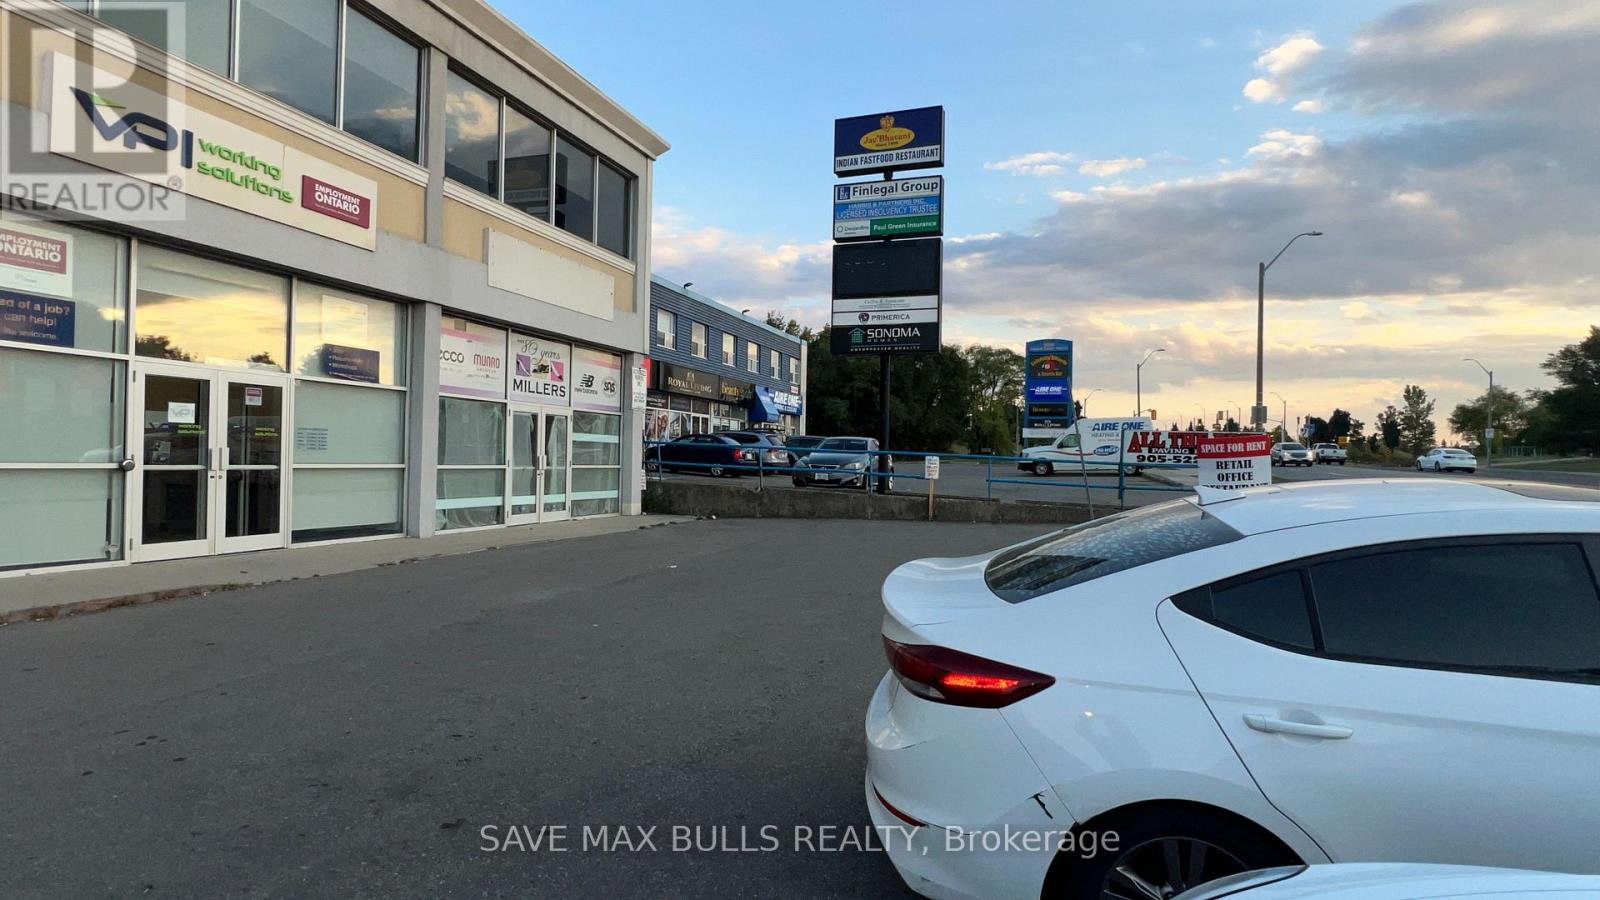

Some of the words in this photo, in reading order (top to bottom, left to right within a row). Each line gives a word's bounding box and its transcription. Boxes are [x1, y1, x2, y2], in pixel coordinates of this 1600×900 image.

[198, 138, 282, 181] working
[836, 156, 859, 169] INDIAN
[860, 153, 894, 166] FASTFOOD
[895, 147, 939, 161] RESTAURANT
[197, 161, 295, 204] solutions
[852, 183, 898, 197] Finlegal
[901, 181, 939, 193] Group
[314, 183, 361, 205] EMPLOYMENT
[314, 191, 361, 216] ONTARIO
[837, 208, 868, 219] LICENSED
[868, 206, 907, 217] INSOLVENCY
[909, 203, 938, 213] TRUSTEE
[888, 222, 906, 230] Green
[18, 301, 32, 310] of
[33, 302, 41, 312] a
[44, 303, 71, 316] job?
[4, 314, 26, 322] can
[871, 313, 910, 321] PRIMERICA
[867, 327, 921, 339] SONOMA
[513, 378, 567, 398] MILLERS
[668, 376, 690, 389] ROYAL
[788, 393, 801, 408] ONE
[1092, 422, 1119, 432] AIRE
[1121, 421, 1144, 431] ONE
[1127, 431, 1166, 453] ALL
[1200, 443, 1226, 453] SPACE
[1227, 442, 1244, 452] FOR
[1246, 441, 1267, 452] RENT
[1216, 460, 1254, 470] RETAIL
[1217, 472, 1254, 482] OFFICE
